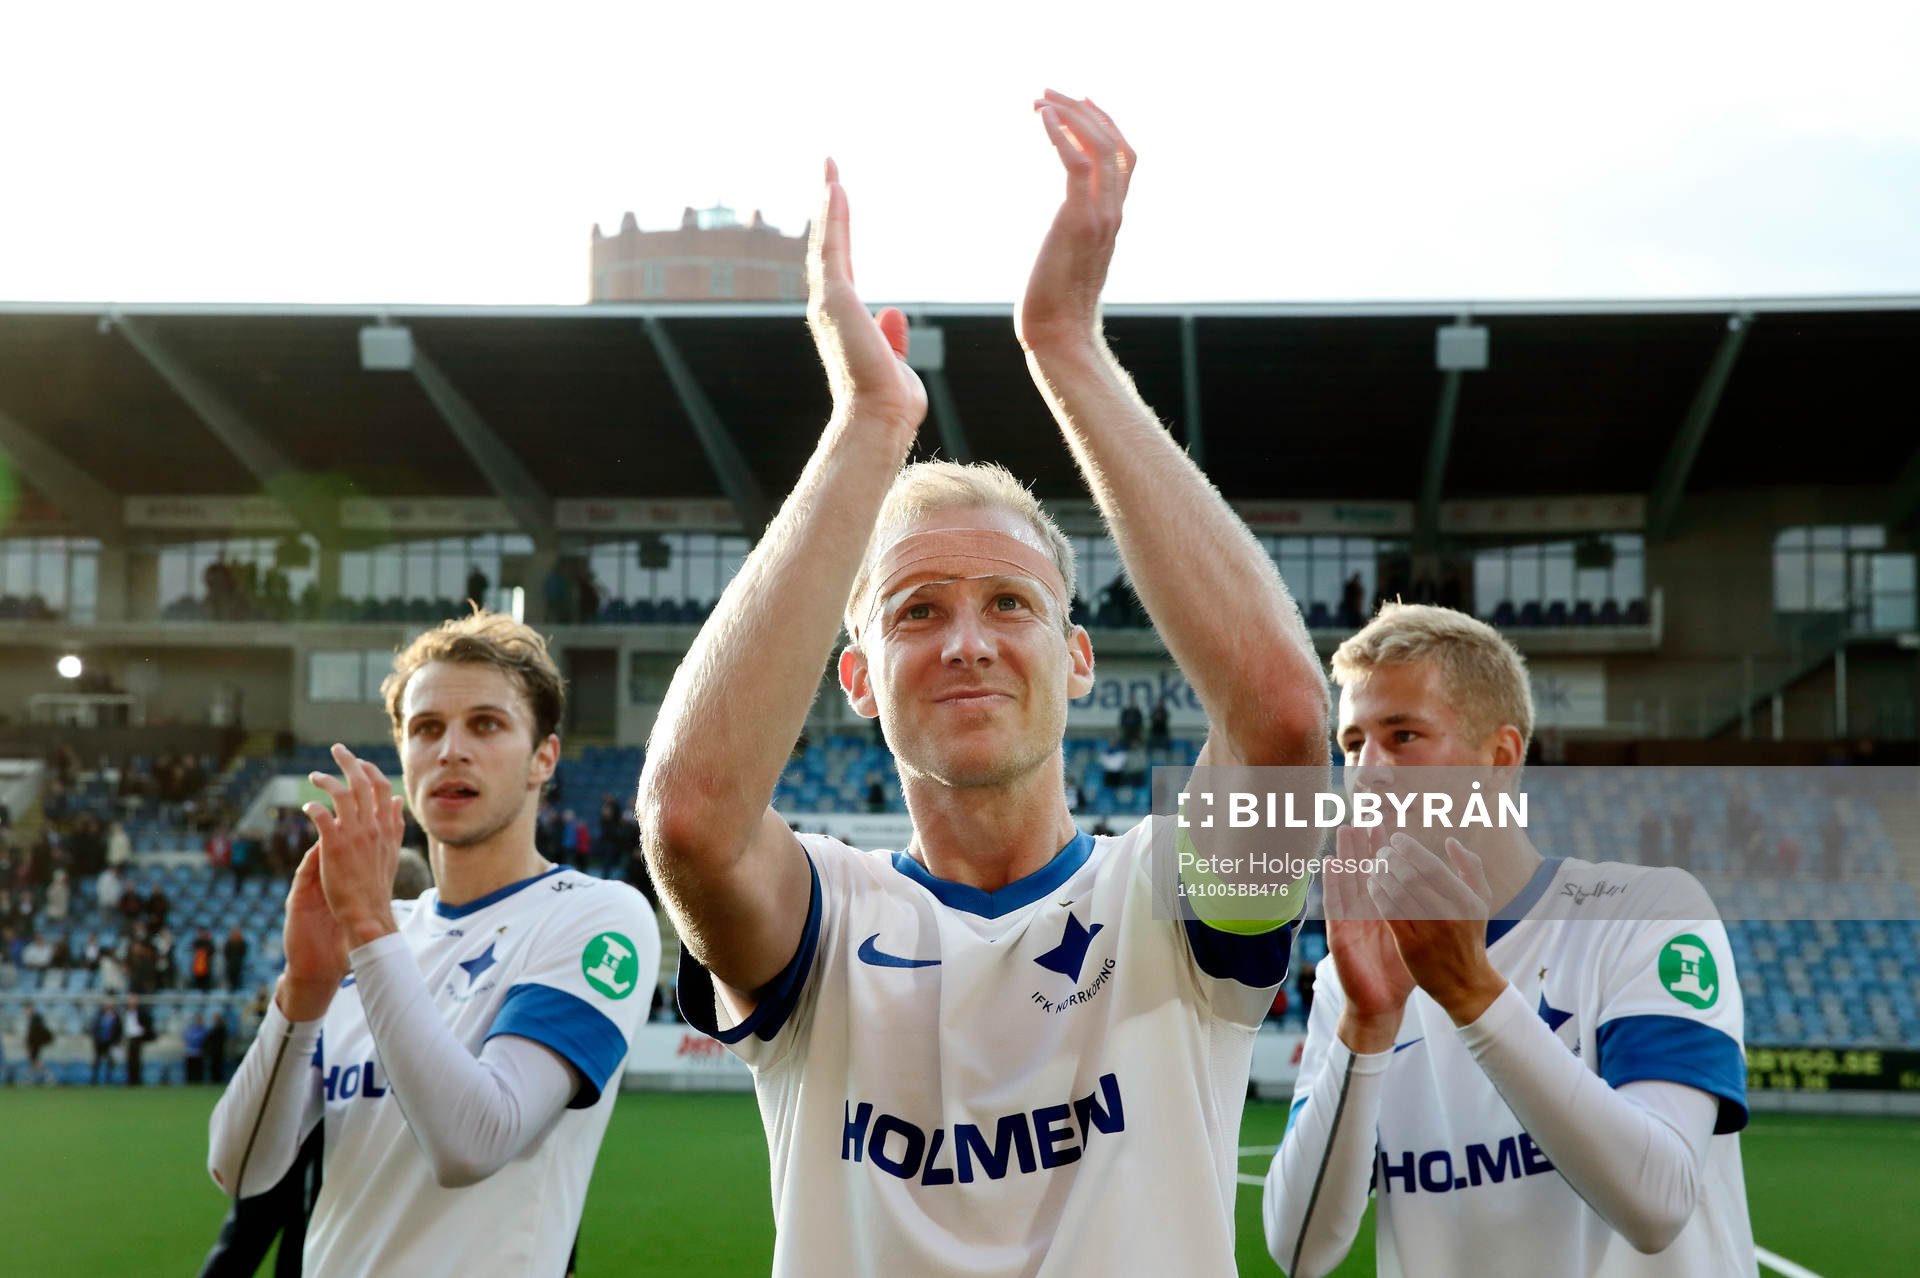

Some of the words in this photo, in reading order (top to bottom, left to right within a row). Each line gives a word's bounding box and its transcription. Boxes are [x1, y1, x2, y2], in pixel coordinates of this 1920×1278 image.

[1031, 991, 1054, 1013] IFK
[1055, 958, 1117, 1014] NORRKÖPING
[841, 1072, 1125, 1186] HOLMEN
